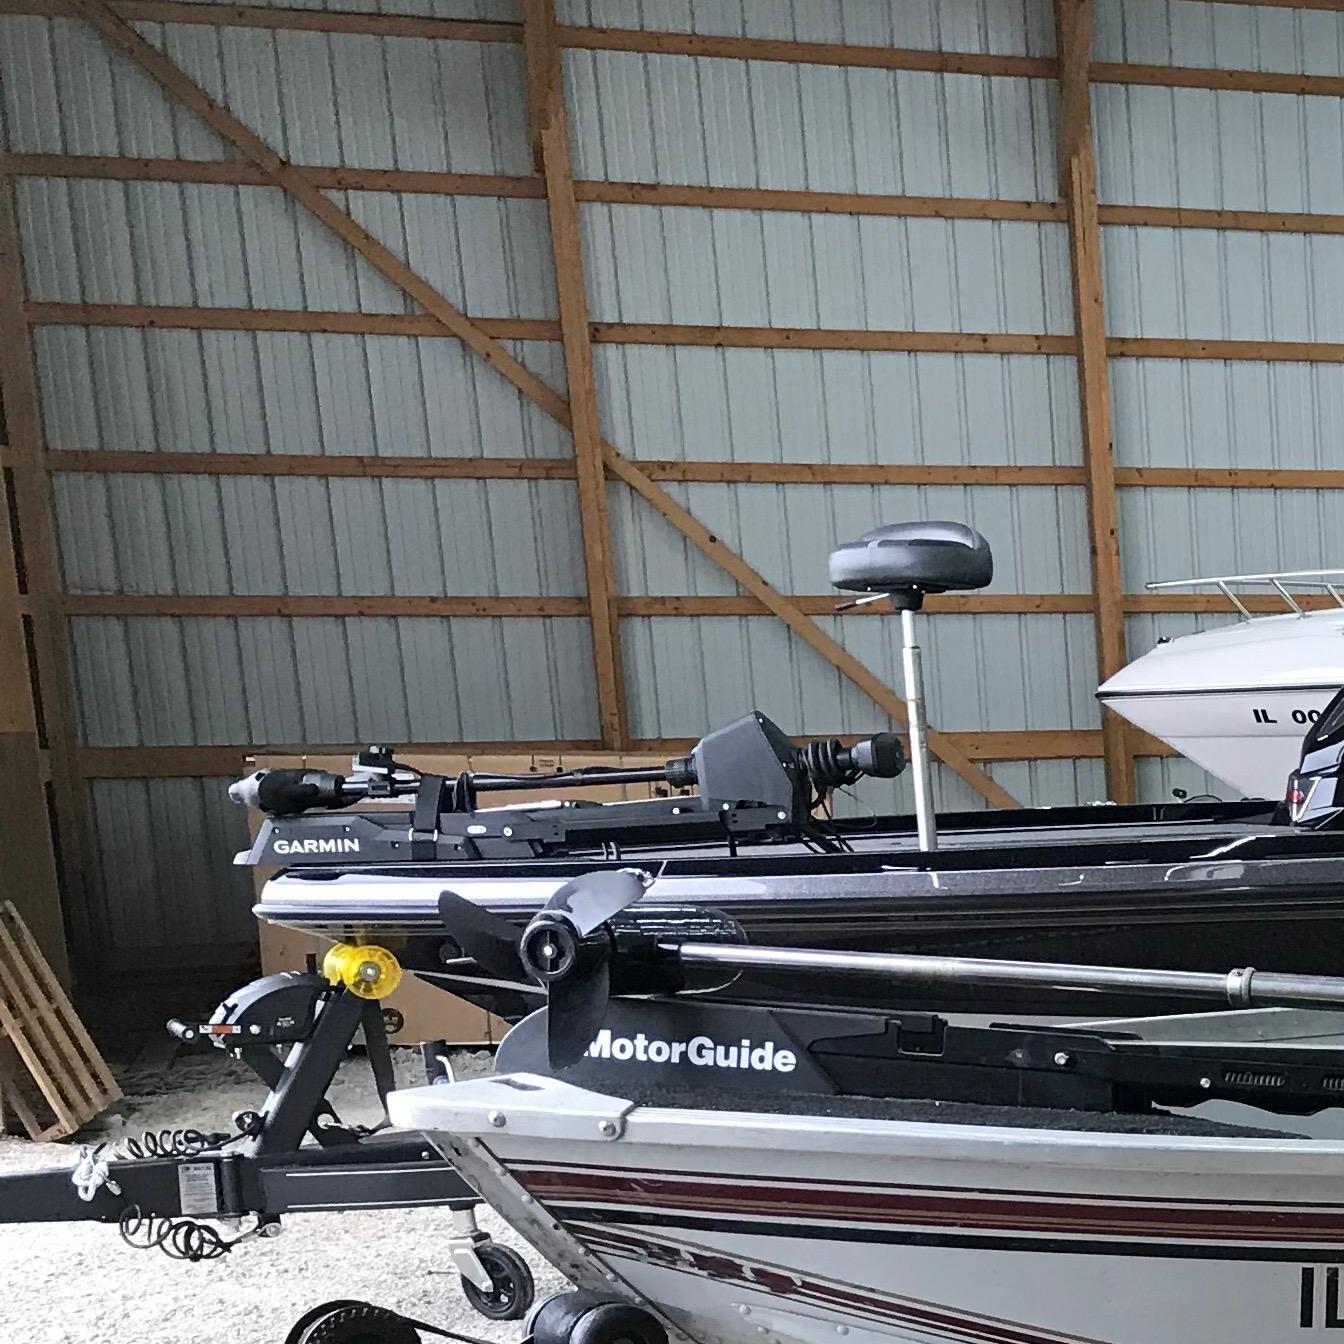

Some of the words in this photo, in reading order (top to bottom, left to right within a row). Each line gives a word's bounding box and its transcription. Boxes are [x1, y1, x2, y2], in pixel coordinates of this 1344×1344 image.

[1252, 708, 1278, 724] IL
[273, 837, 360, 854] GARMIN
[583, 1029, 797, 1073] MotorGuide
